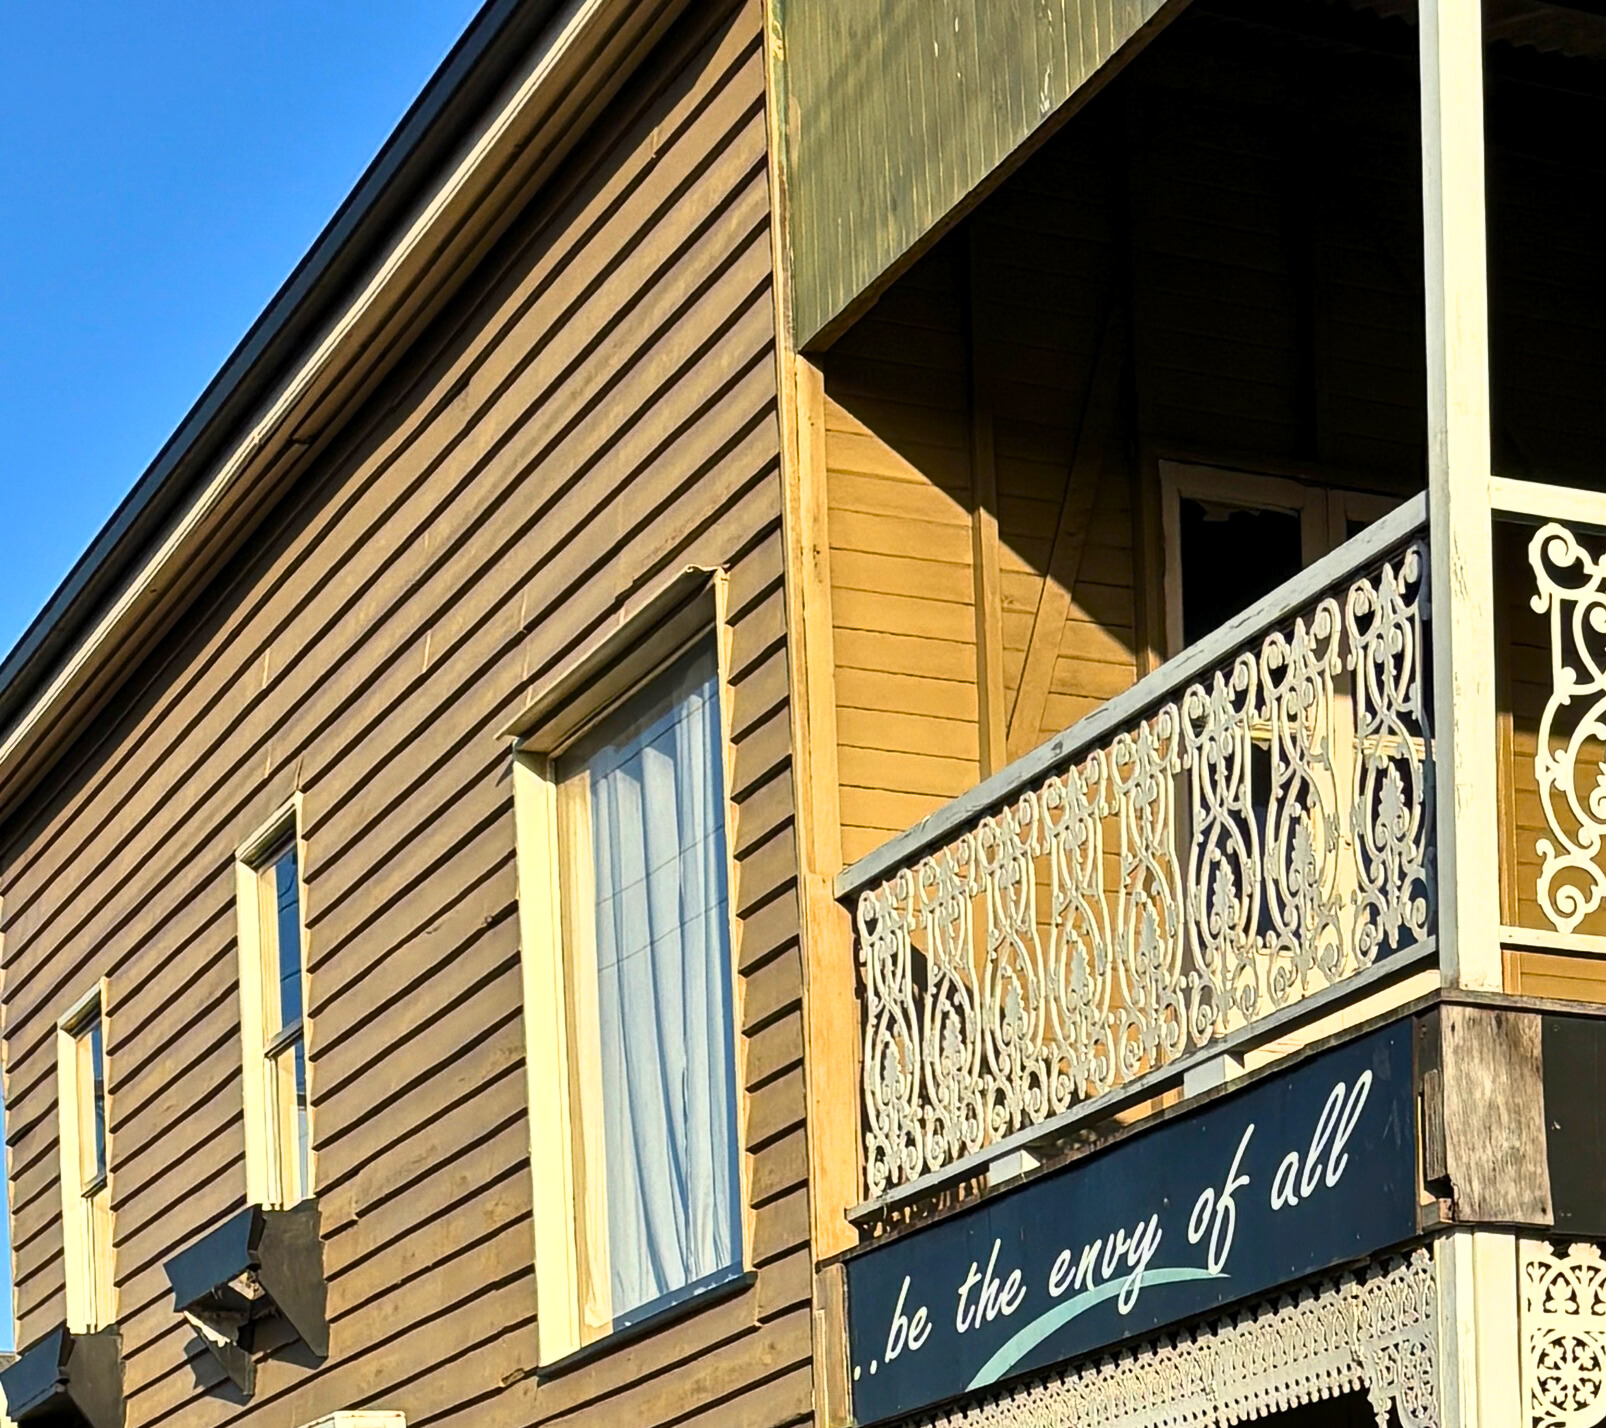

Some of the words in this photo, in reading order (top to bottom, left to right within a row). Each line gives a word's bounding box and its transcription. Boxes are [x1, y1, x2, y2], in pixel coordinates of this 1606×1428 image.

[955, 1237, 1026, 1334] the
[1047, 1213, 1162, 1315] envy
[1188, 1122, 1255, 1276] of
[1270, 1069, 1373, 1211] all
